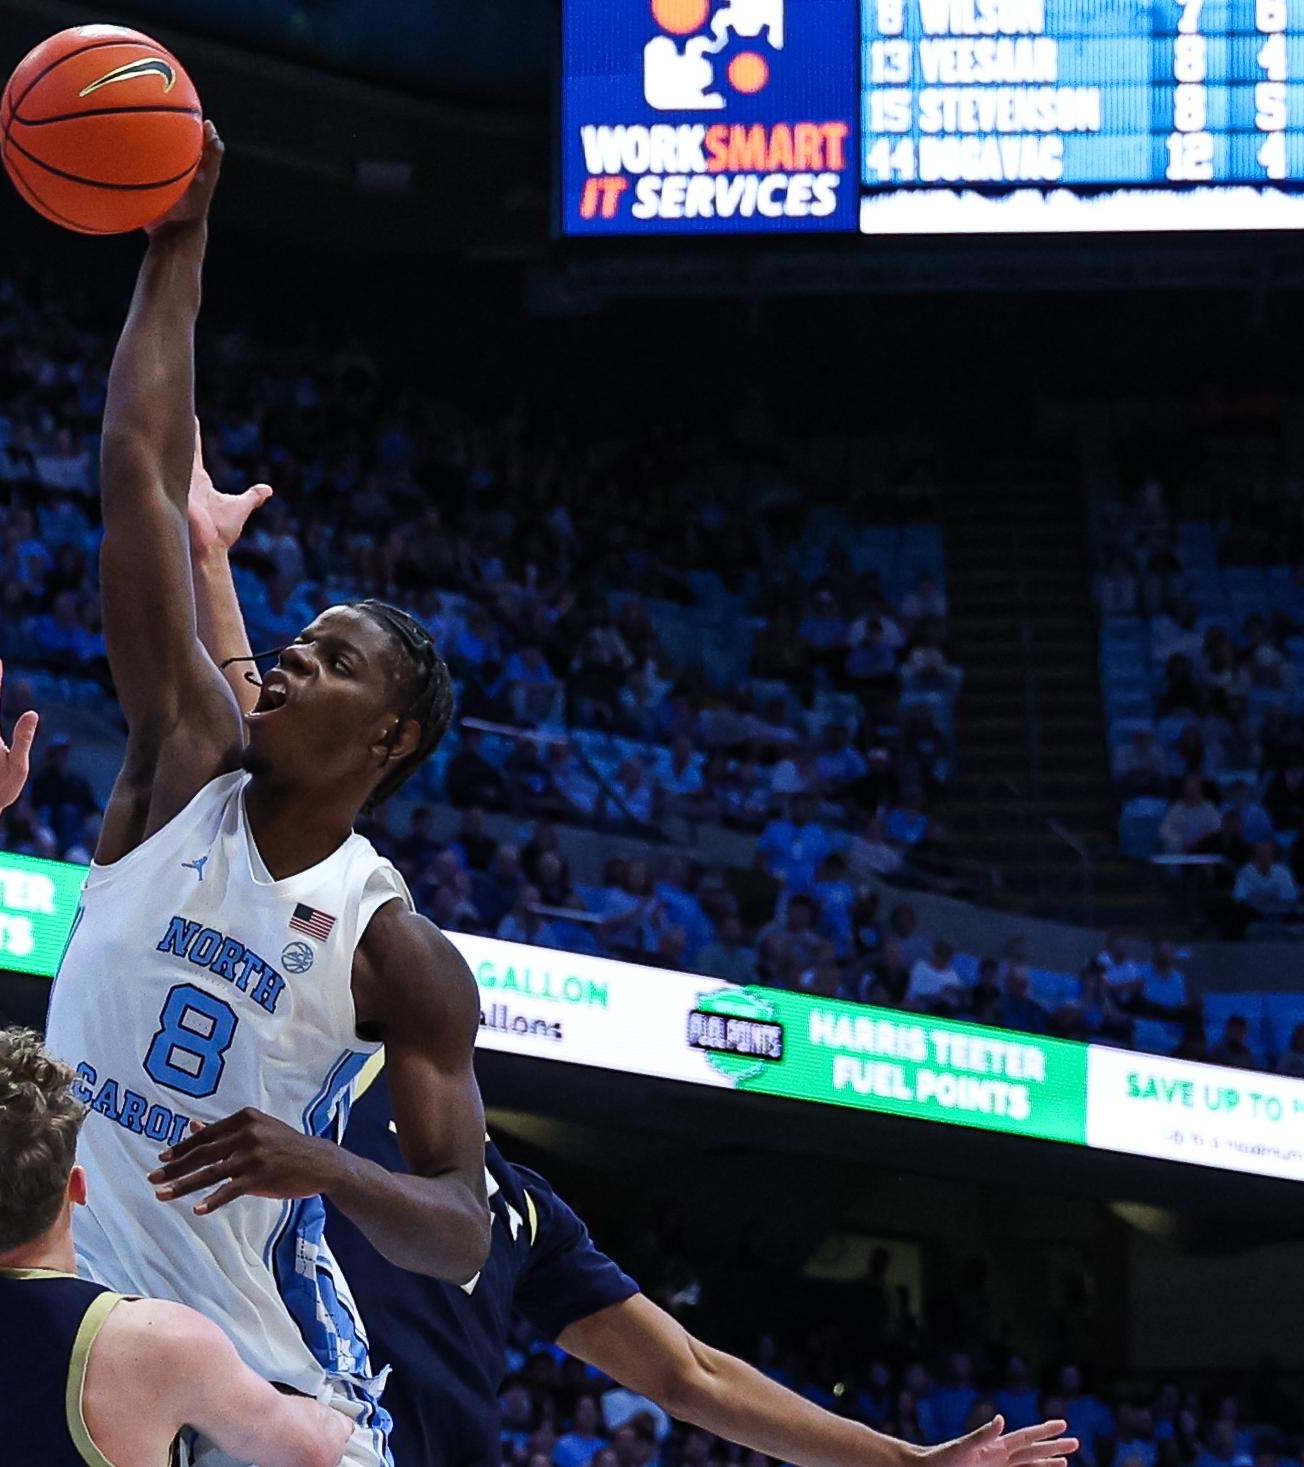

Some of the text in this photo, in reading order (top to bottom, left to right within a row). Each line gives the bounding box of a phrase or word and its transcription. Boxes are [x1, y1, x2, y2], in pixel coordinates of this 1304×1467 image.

[1175, 0, 1203, 33] 7
[871, 38, 910, 82] 13
[1174, 34, 1205, 82] 8
[1257, 33, 1287, 81] 4
[871, 82, 1287, 132] 15 STEVENSON 8 5
[580, 122, 848, 174] WORKSMART
[867, 135, 913, 181] 44
[1166, 131, 1213, 181] 12
[1257, 131, 1287, 180] 4
[580, 172, 840, 219] IT SERVICES
[156, 916, 287, 1015] NORTH
[477, 960, 609, 1009] GALLON
[143, 983, 239, 1099] 8
[808, 1009, 1046, 1083] HARRIS TEETER
[833, 1055, 1030, 1120] FUEL POINTS
[1127, 1071, 1194, 1107] SAVE
[1204, 1084, 1240, 1113] UP
[1248, 1092, 1284, 1121] TO
